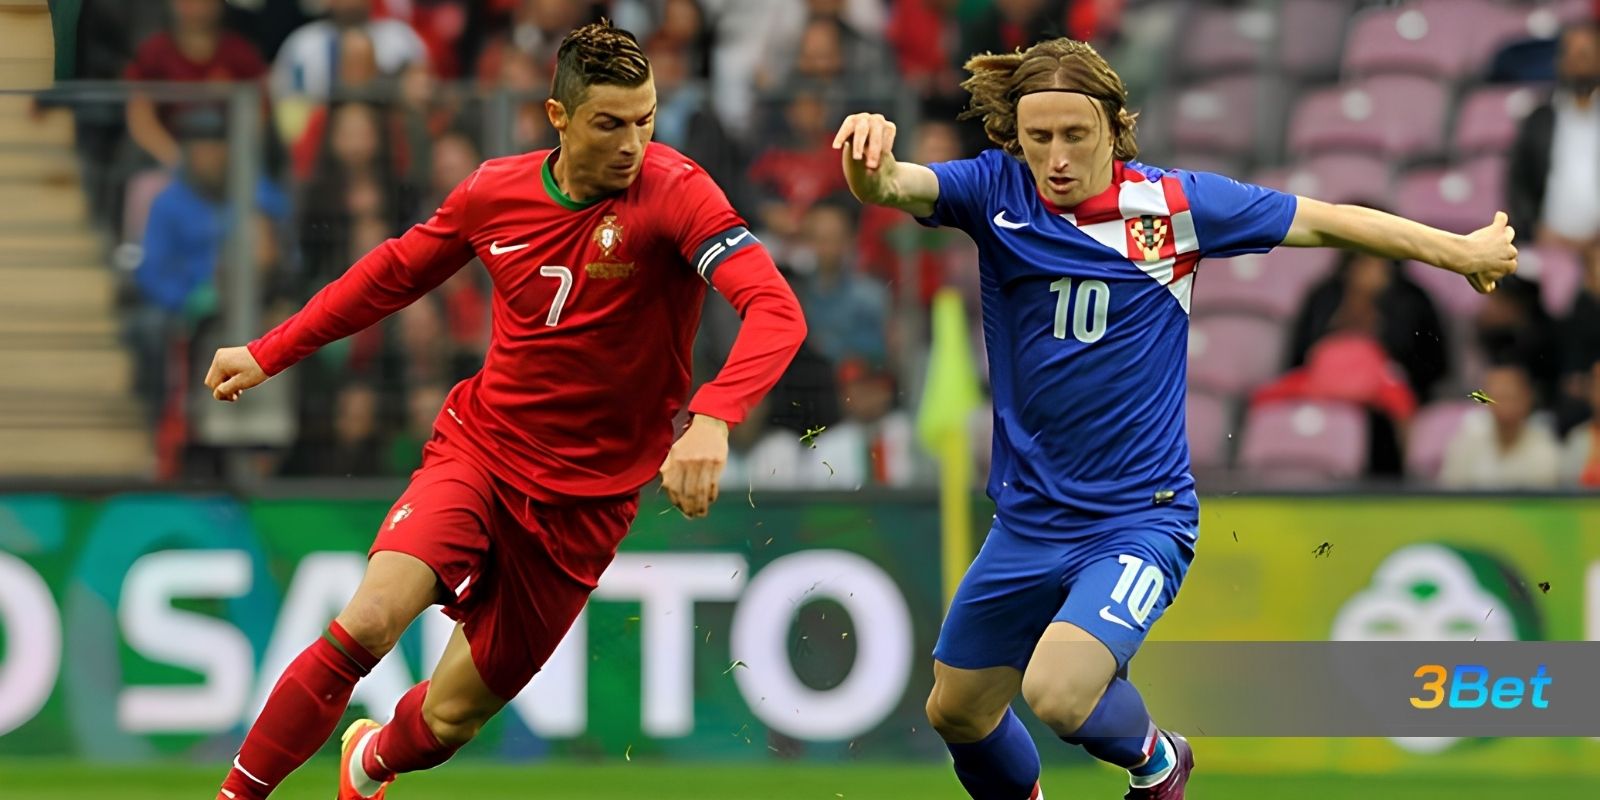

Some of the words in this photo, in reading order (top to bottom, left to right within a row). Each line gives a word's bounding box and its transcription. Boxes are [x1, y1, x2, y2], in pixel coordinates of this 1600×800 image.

[540, 265, 573, 327] 7
[1050, 276, 1110, 343] 10
[1110, 553, 1165, 625] 10
